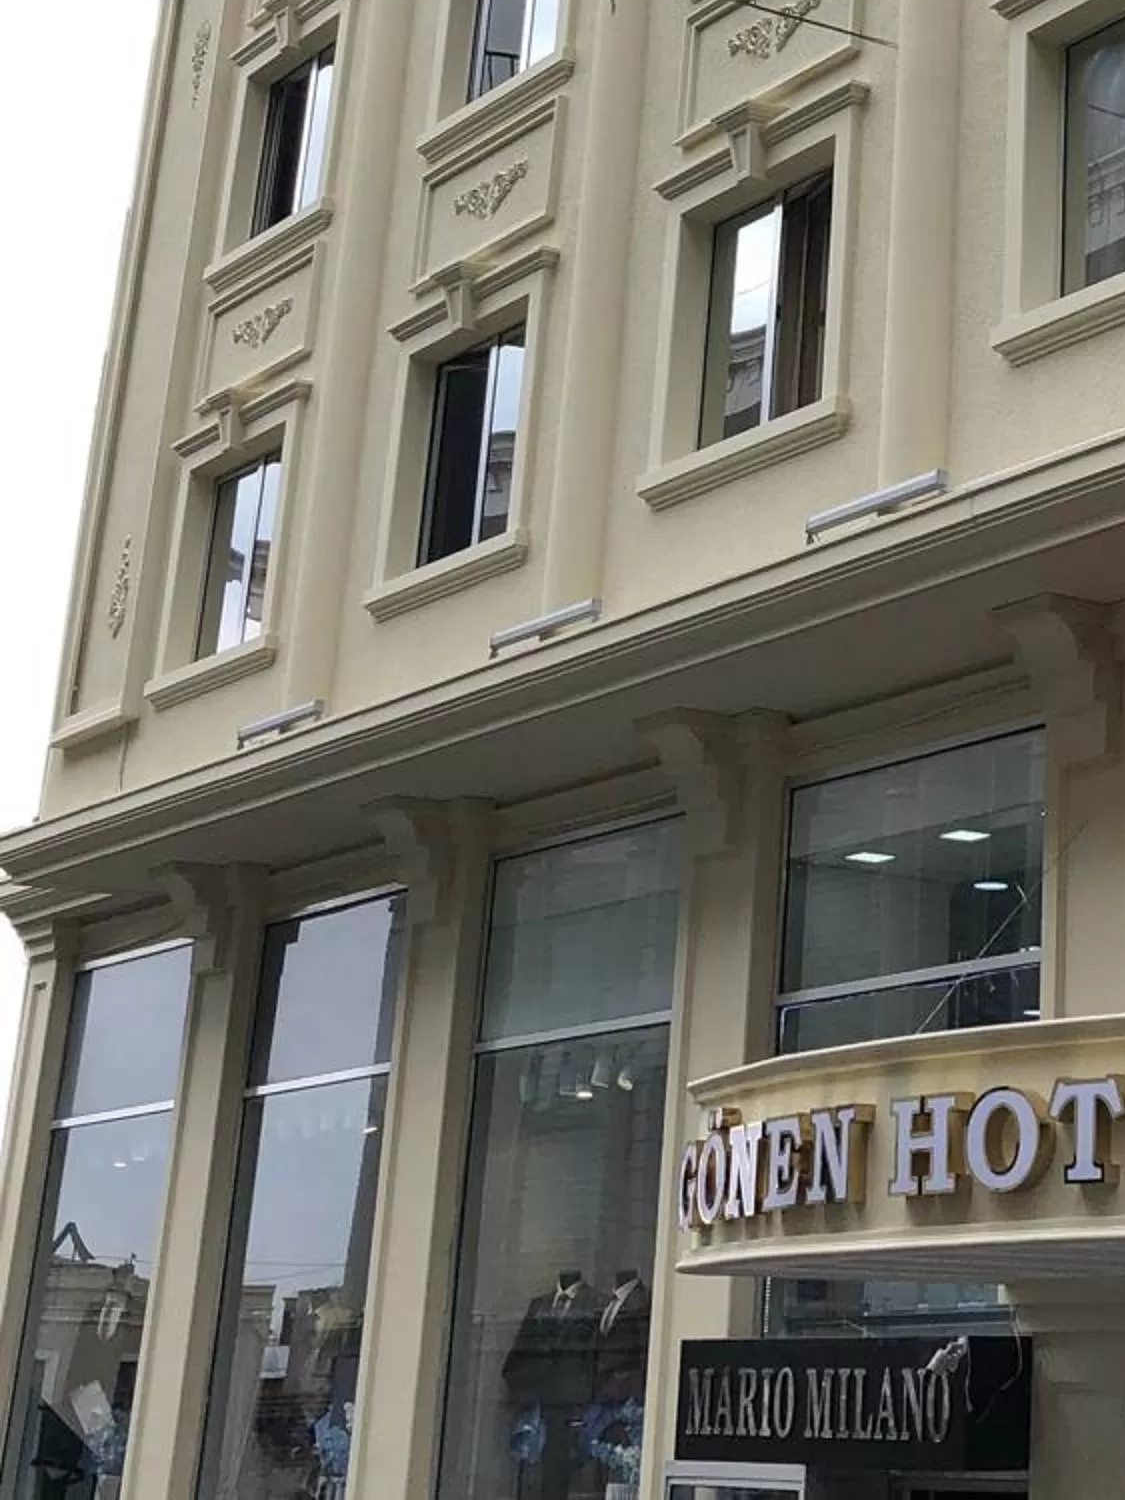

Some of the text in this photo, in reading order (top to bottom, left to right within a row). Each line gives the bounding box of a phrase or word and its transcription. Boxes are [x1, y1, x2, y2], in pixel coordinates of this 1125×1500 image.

[678, 1104, 874, 1230] GÖNEN
[685, 1366, 950, 1443] MARIO MILANO
